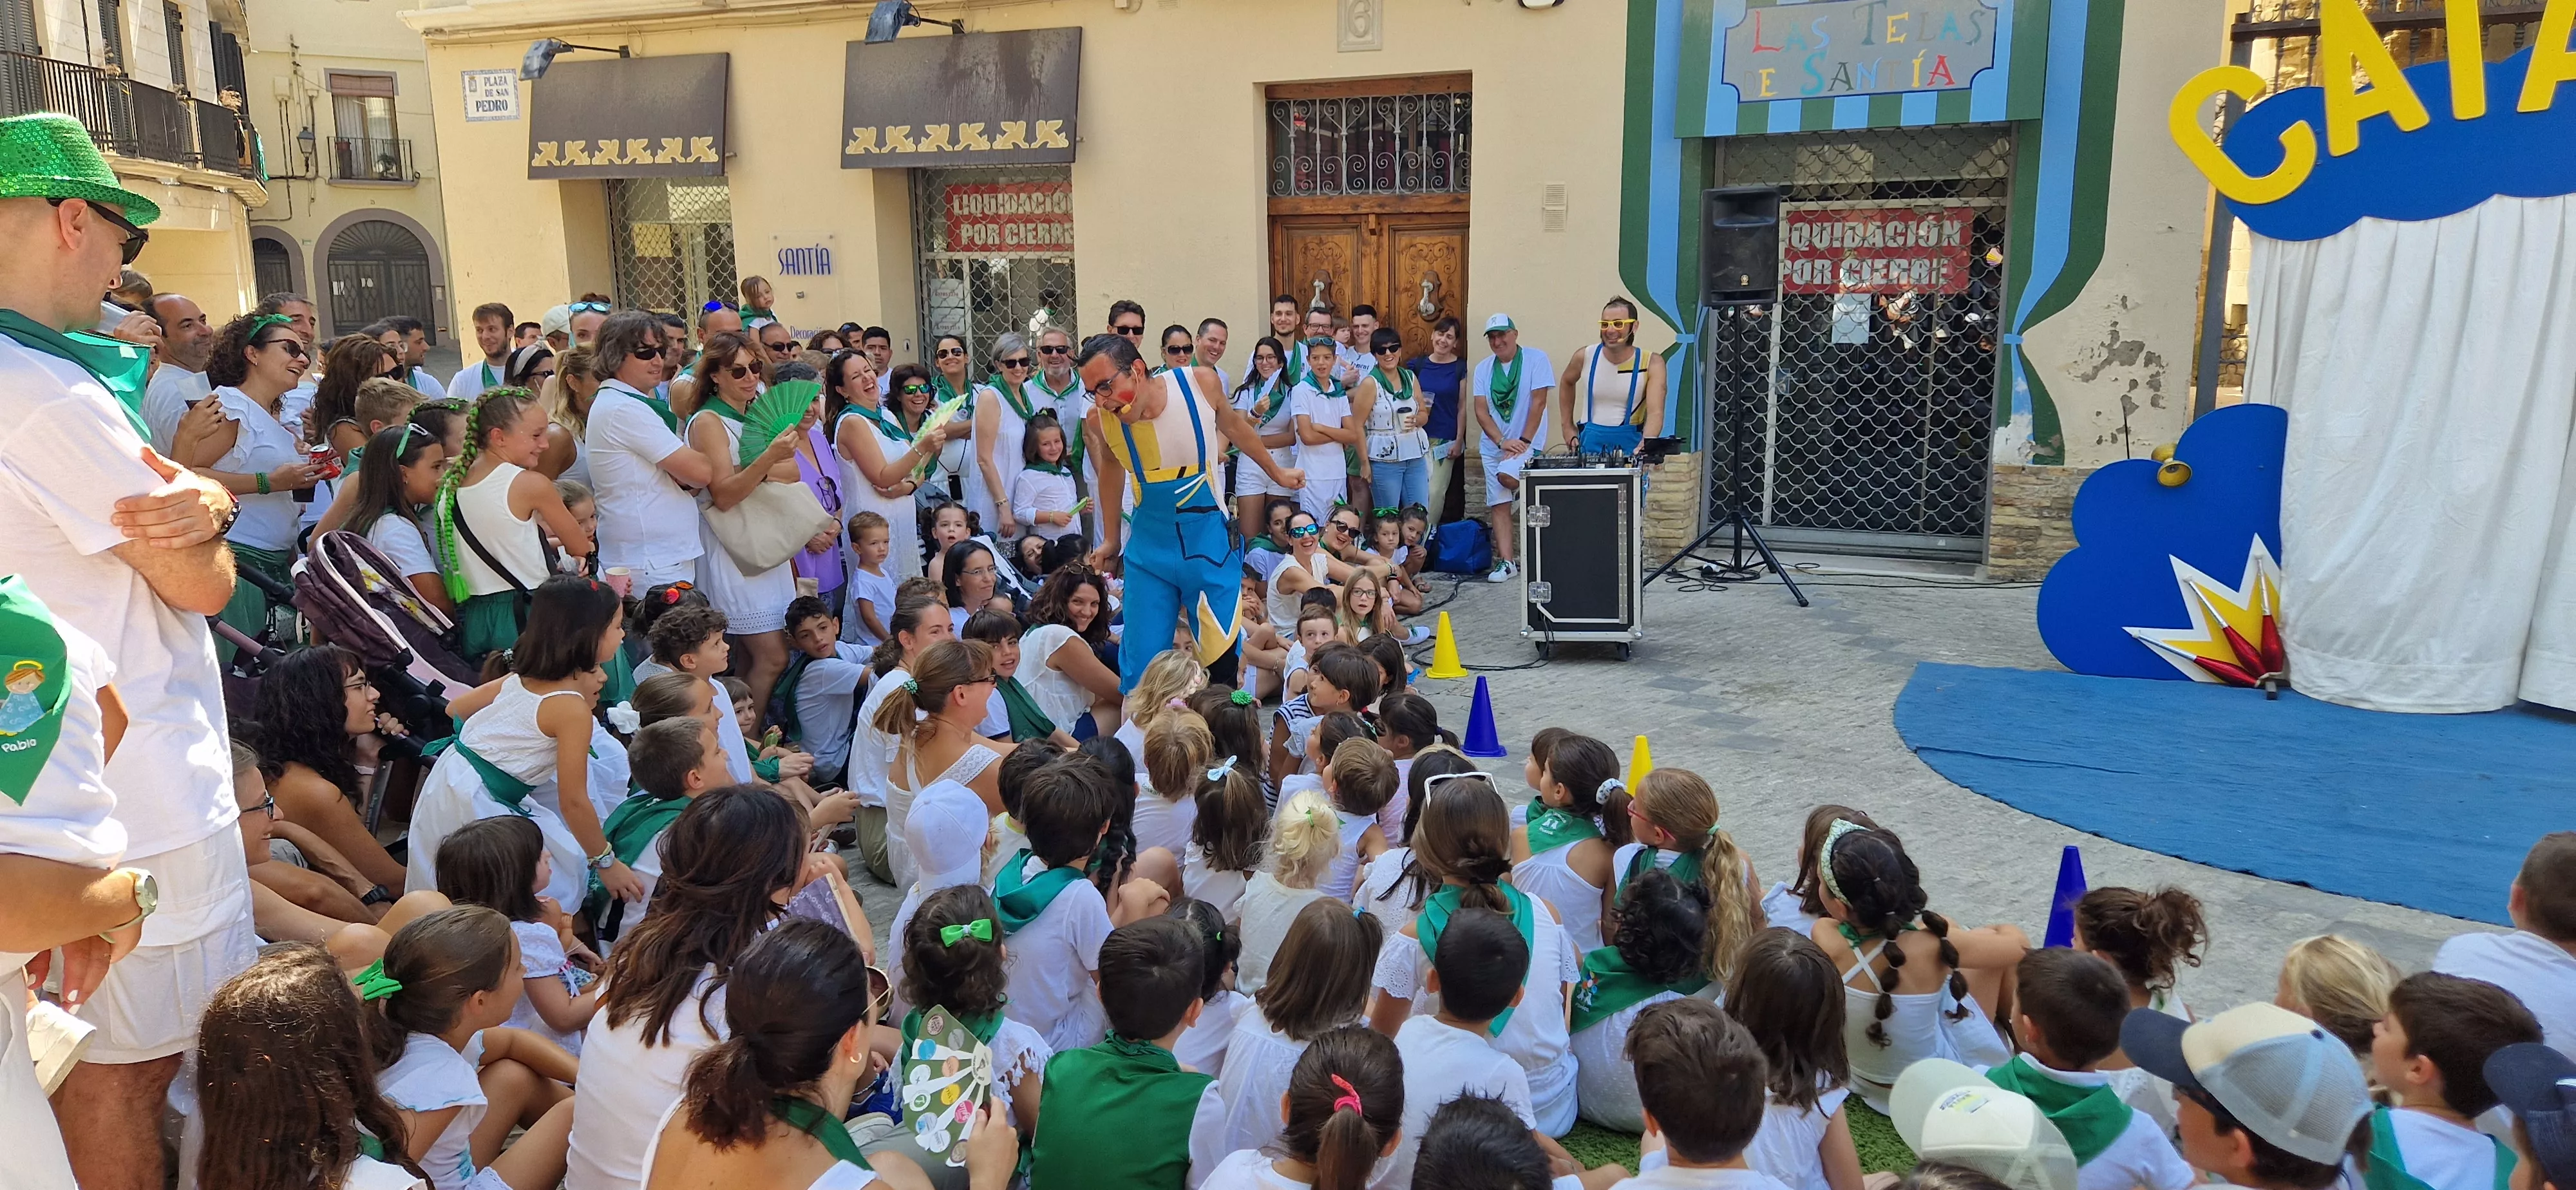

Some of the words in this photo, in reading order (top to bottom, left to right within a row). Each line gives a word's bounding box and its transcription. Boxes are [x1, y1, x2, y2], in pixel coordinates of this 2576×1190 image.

[1348, 0, 1371, 38] 6
[1752, 10, 1830, 53] LAS
[1852, 1, 1985, 46] TELAS
[484, 76, 508, 87] PLAZA
[1744, 68, 1779, 97] DE
[1800, 49, 1955, 96] SANTÍA
[485, 89, 494, 97] DE
[496, 88, 509, 97] SAN
[475, 99, 508, 112] PEDRO
[961, 223, 1000, 245] POR
[778, 243, 831, 275] SANTÍA
[1841, 258, 1948, 285] CIERRE
[1, 738, 37, 752] Pablo
